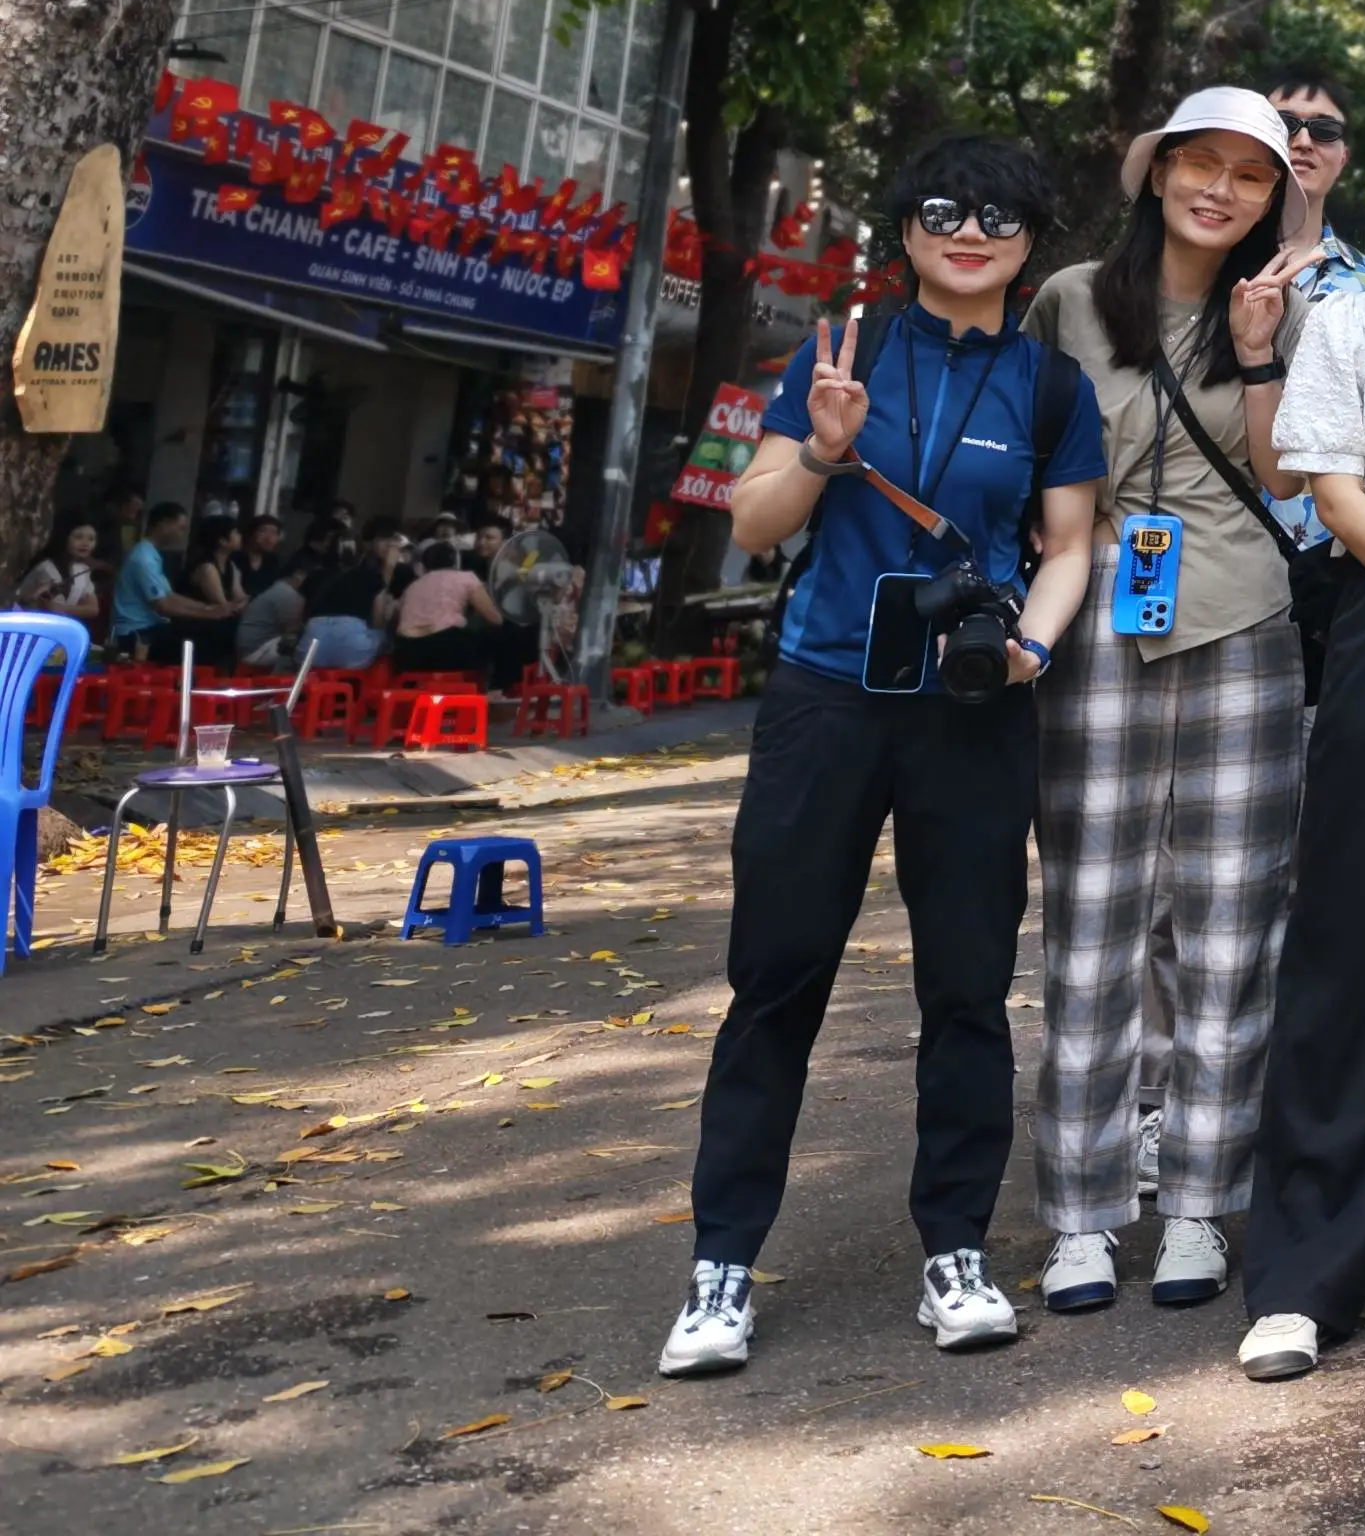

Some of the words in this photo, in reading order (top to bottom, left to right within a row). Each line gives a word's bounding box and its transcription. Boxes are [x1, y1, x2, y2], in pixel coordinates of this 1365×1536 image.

[245, 202, 325, 247] CHANH
[412, 244, 460, 279] SINH
[56, 253, 80, 264] ART
[51, 305, 80, 318] SOUL
[33, 341, 101, 372] AMES
